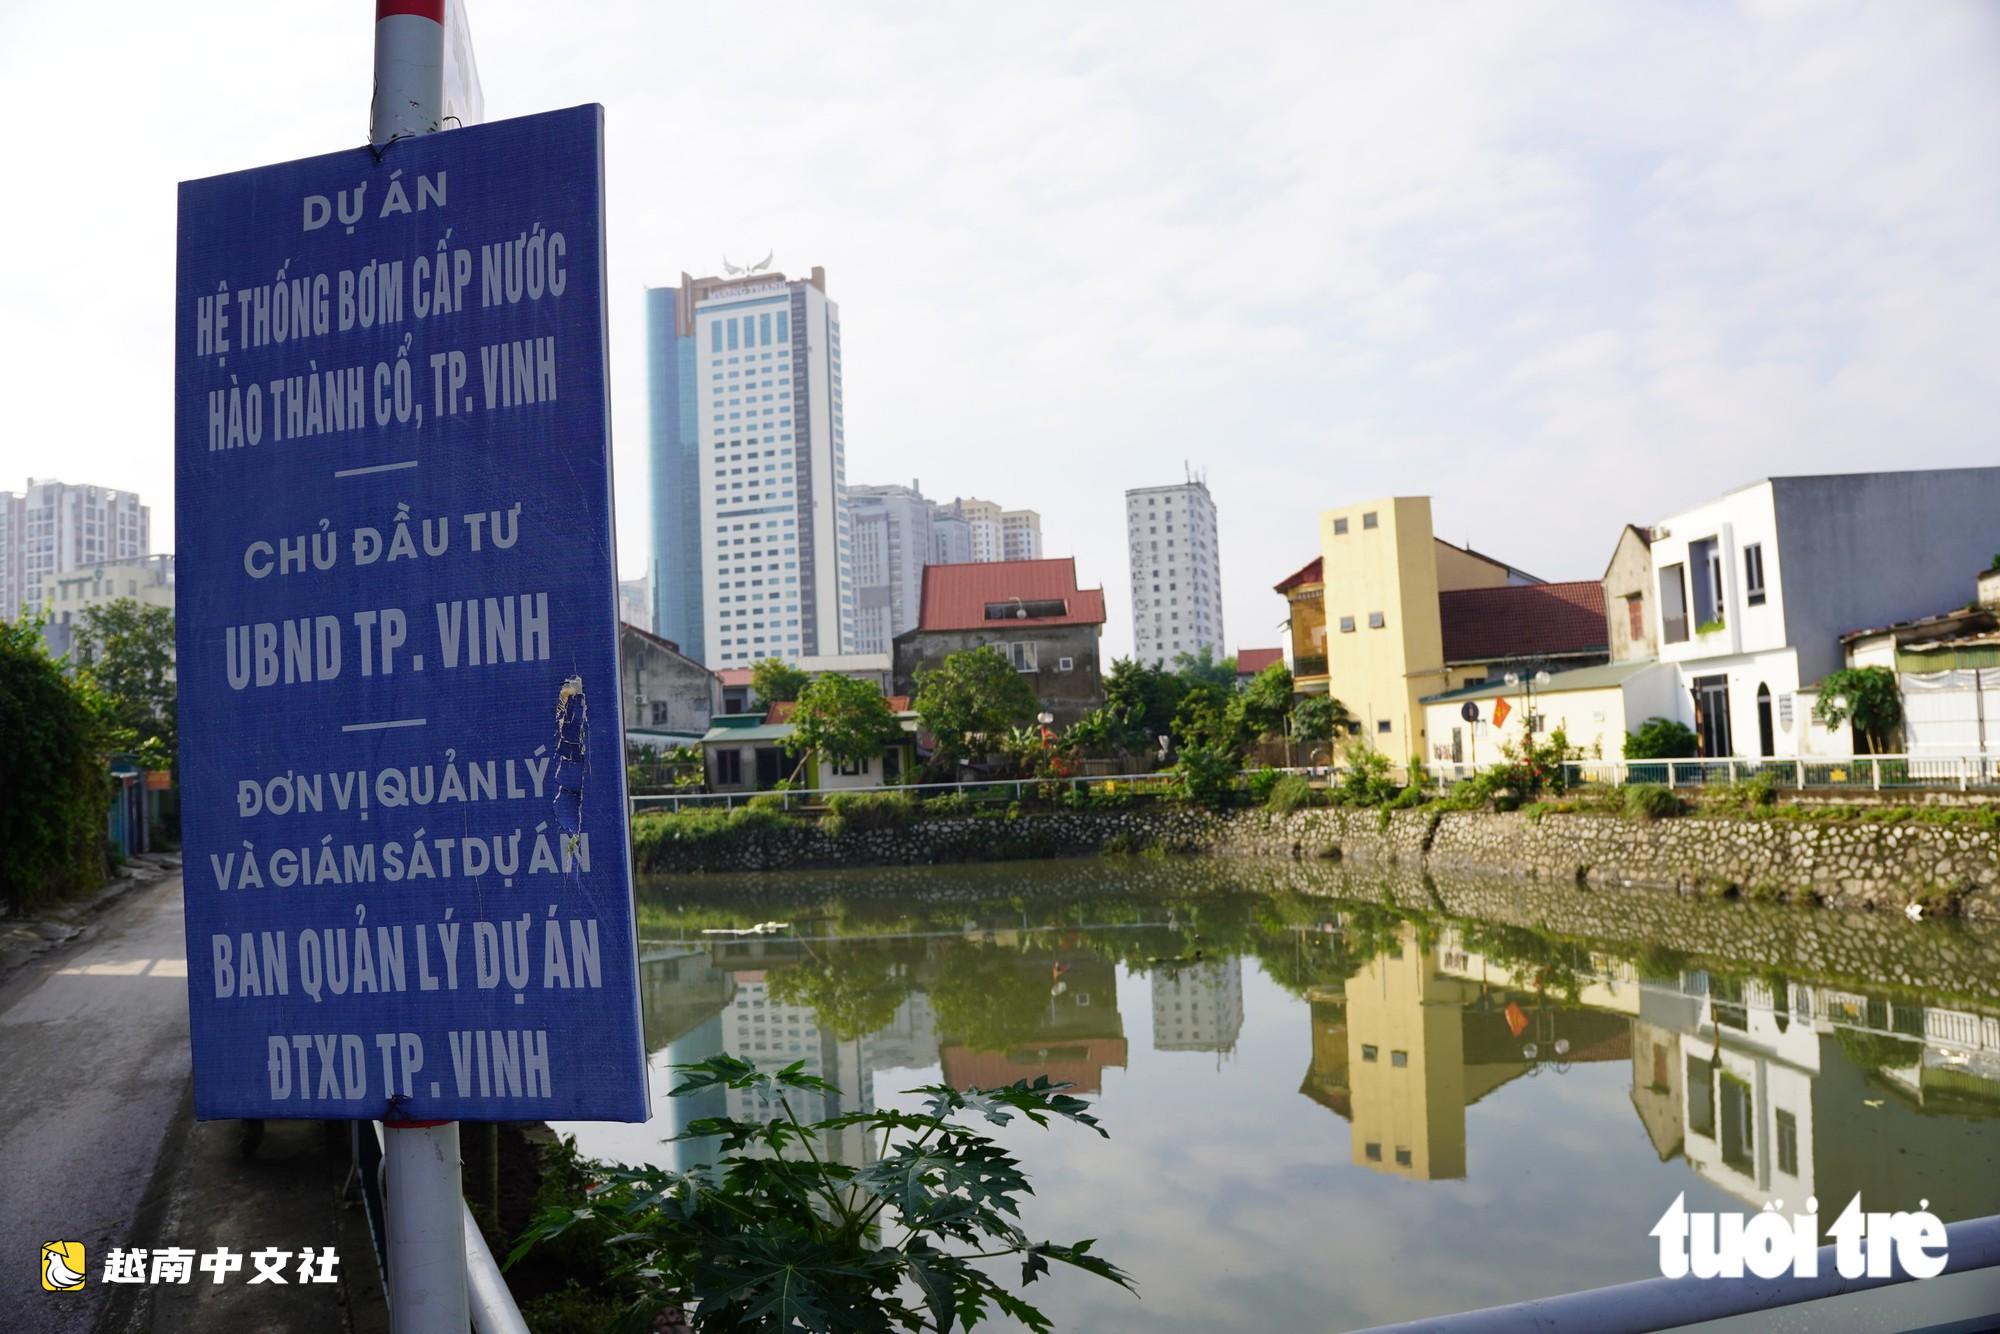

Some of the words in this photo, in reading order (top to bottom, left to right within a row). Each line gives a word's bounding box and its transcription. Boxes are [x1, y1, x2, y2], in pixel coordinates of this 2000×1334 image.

[304, 181, 366, 234] DỰ
[380, 169, 446, 217] ÁN
[198, 280, 229, 367] HỆ
[238, 259, 329, 348] THỐNG
[339, 259, 402, 331] BƠM
[413, 229, 471, 318] CẤP
[482, 222, 566, 307] NƯỚC
[210, 375, 262, 451] HÀO
[271, 360, 364, 441] THÀNH
[374, 332, 422, 429] CỔ,
[431, 351, 472, 416] TP.
[481, 336, 556, 409] VINH
[244, 519, 336, 578] CHỦ
[352, 502, 448, 565] ĐẦU
[464, 502, 521, 551] TƯ
[227, 616, 341, 689] UBND
[355, 609, 423, 676] TP.
[436, 592, 549, 668] VINH
[237, 770, 322, 817] ĐƠN
[330, 771, 368, 820] VỊ
[376, 748, 497, 807] QUẢN
[506, 745, 550, 798] LÝ
[211, 840, 264, 890] VÀ
[270, 834, 375, 887] GIÁM
[383, 827, 454, 881] SÁT
[462, 829, 521, 887] DỰ
[528, 821, 591, 873] ÁN
[213, 931, 288, 997] BAN
[299, 904, 406, 1002] QUẢN
[416, 908, 459, 990] LÝ
[473, 913, 531, 1004] DỰ
[544, 905, 601, 988] ÁN
[268, 1035, 366, 1099] ĐTXD
[376, 1033, 440, 1098] TP.
[449, 1031, 551, 1097] VINH
